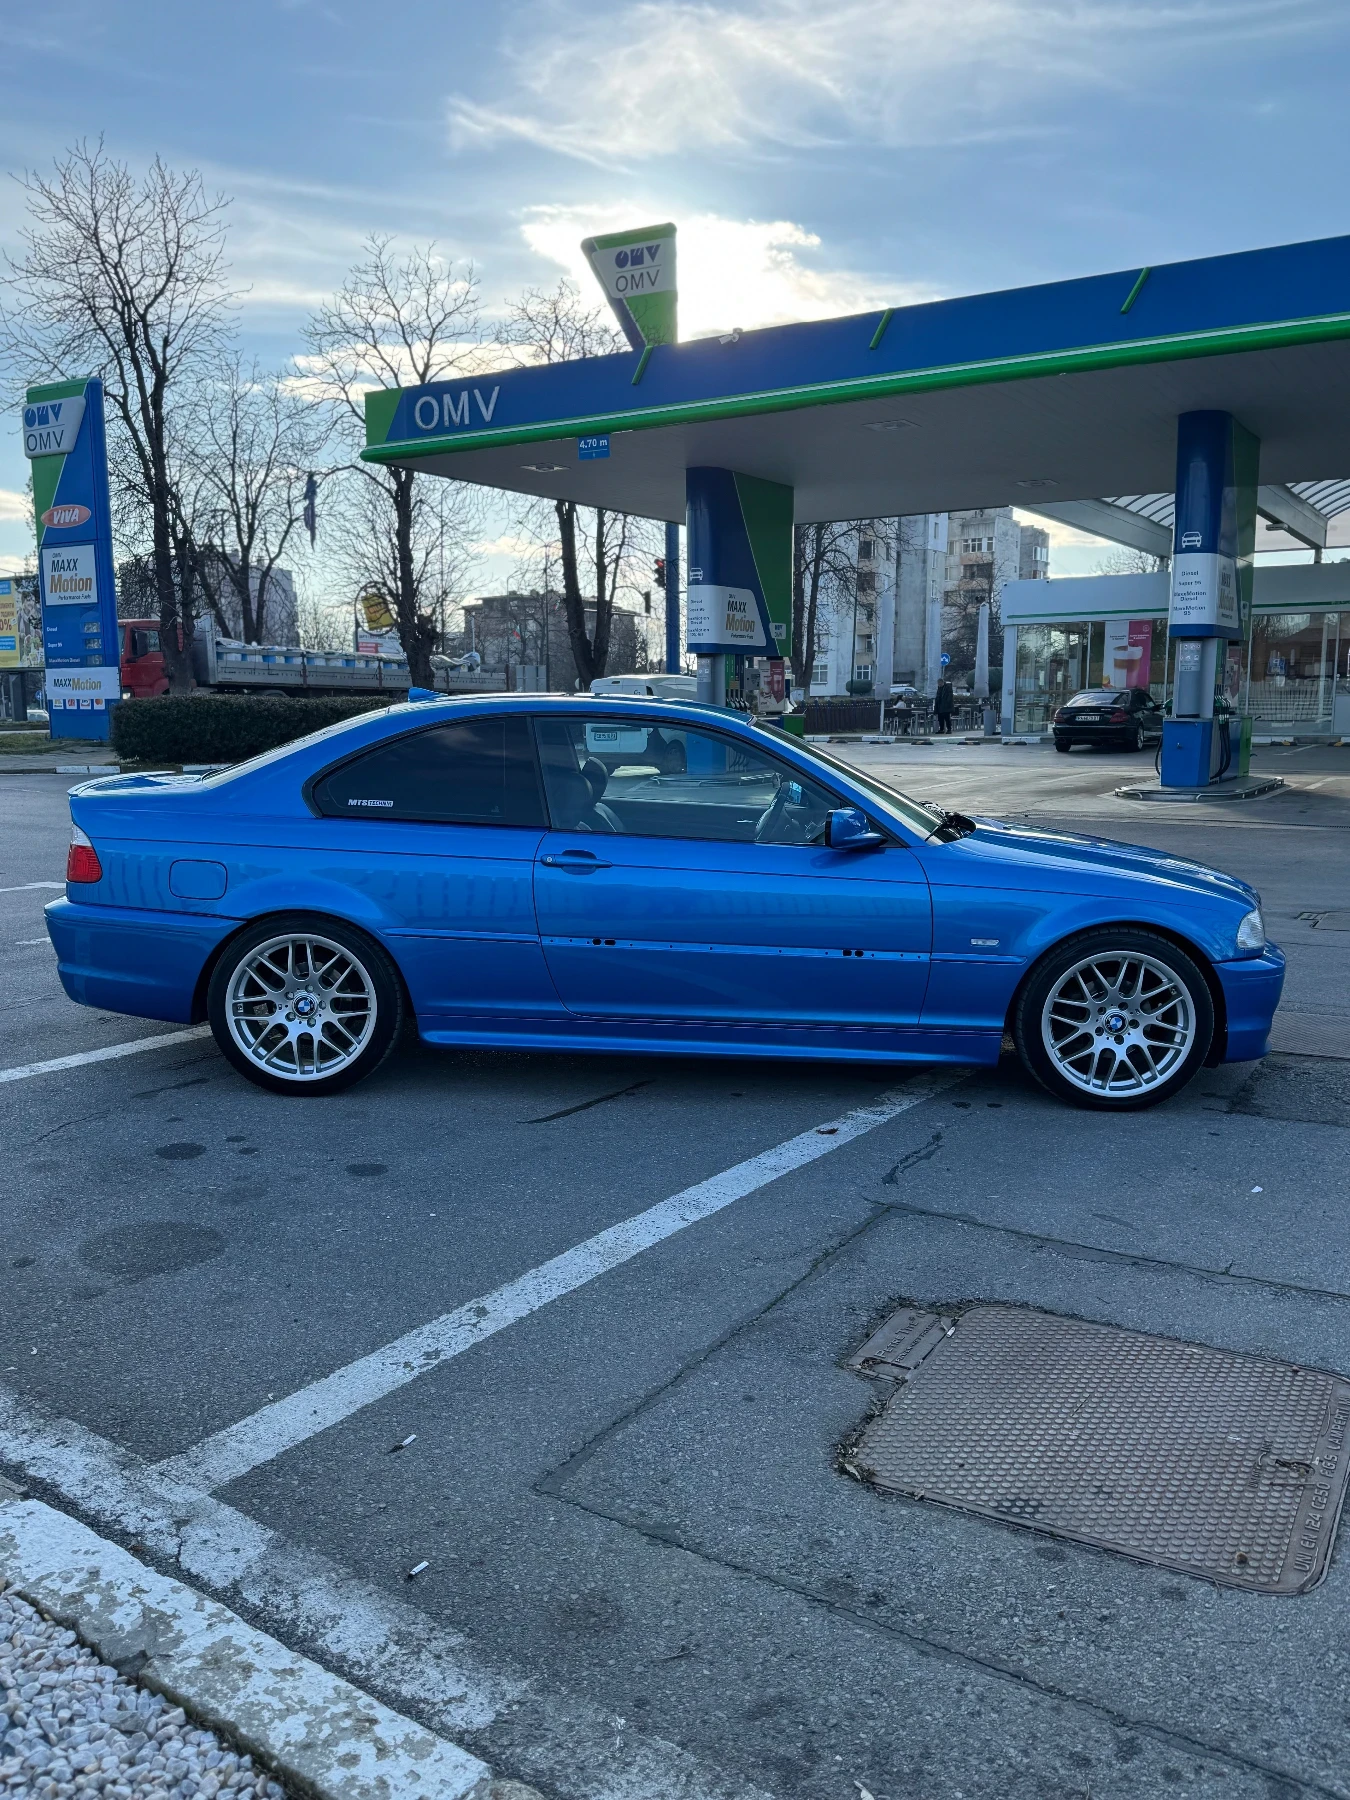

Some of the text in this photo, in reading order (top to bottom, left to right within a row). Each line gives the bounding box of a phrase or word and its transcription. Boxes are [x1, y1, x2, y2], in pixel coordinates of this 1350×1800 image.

[615, 269, 660, 293] OMV
[414, 386, 500, 431] OMV
[27, 430, 64, 452] OMV
[580, 438, 608, 449] 4.70 m
[53, 508, 79, 524] VIVA
[51, 558, 78, 573] MAXX
[50, 573, 92, 593] Motion
[727, 600, 747, 613] MAXX
[725, 613, 755, 632] Motion
[53, 678, 102, 691] MAXX Motion
[1311, 1482, 1331, 1510] C250
[1305, 1512, 1323, 1532] 124
[1300, 1533, 1318, 1549] EN
[1294, 1552, 1313, 1572] UNI
